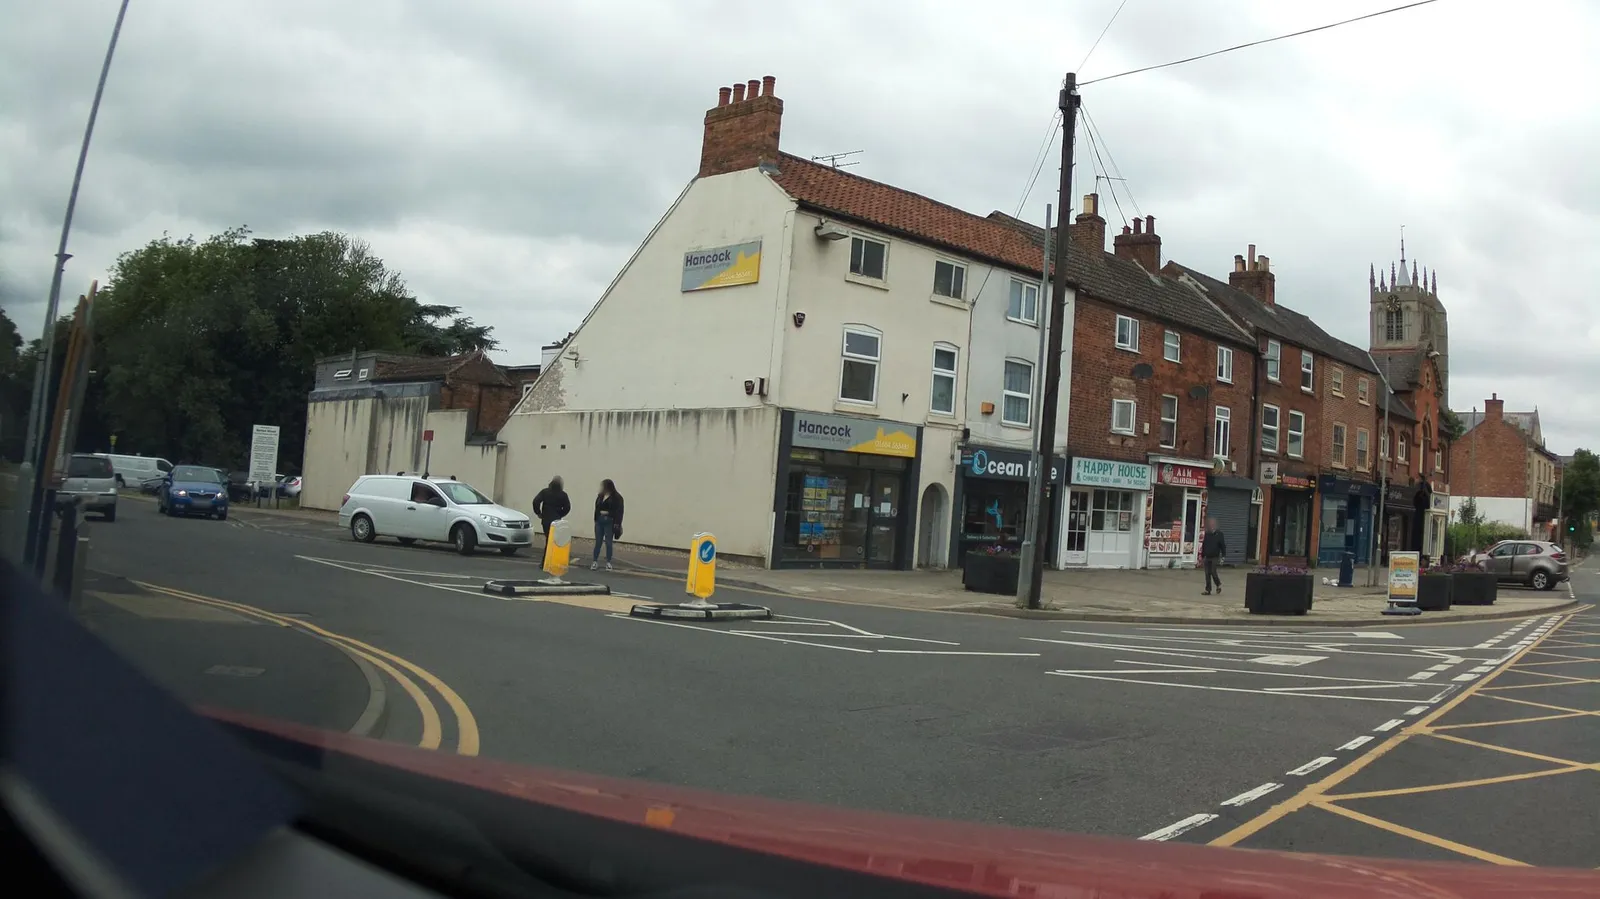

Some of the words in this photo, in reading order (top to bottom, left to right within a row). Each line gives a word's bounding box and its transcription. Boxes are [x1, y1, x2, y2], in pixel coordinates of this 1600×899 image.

[685, 249, 731, 267] Hancock
[798, 419, 852, 438] Hancock
[972, 449, 1024, 477] Ocean
[1083, 460, 1115, 476] HAPPY
[1118, 465, 1147, 480] HOUSE
